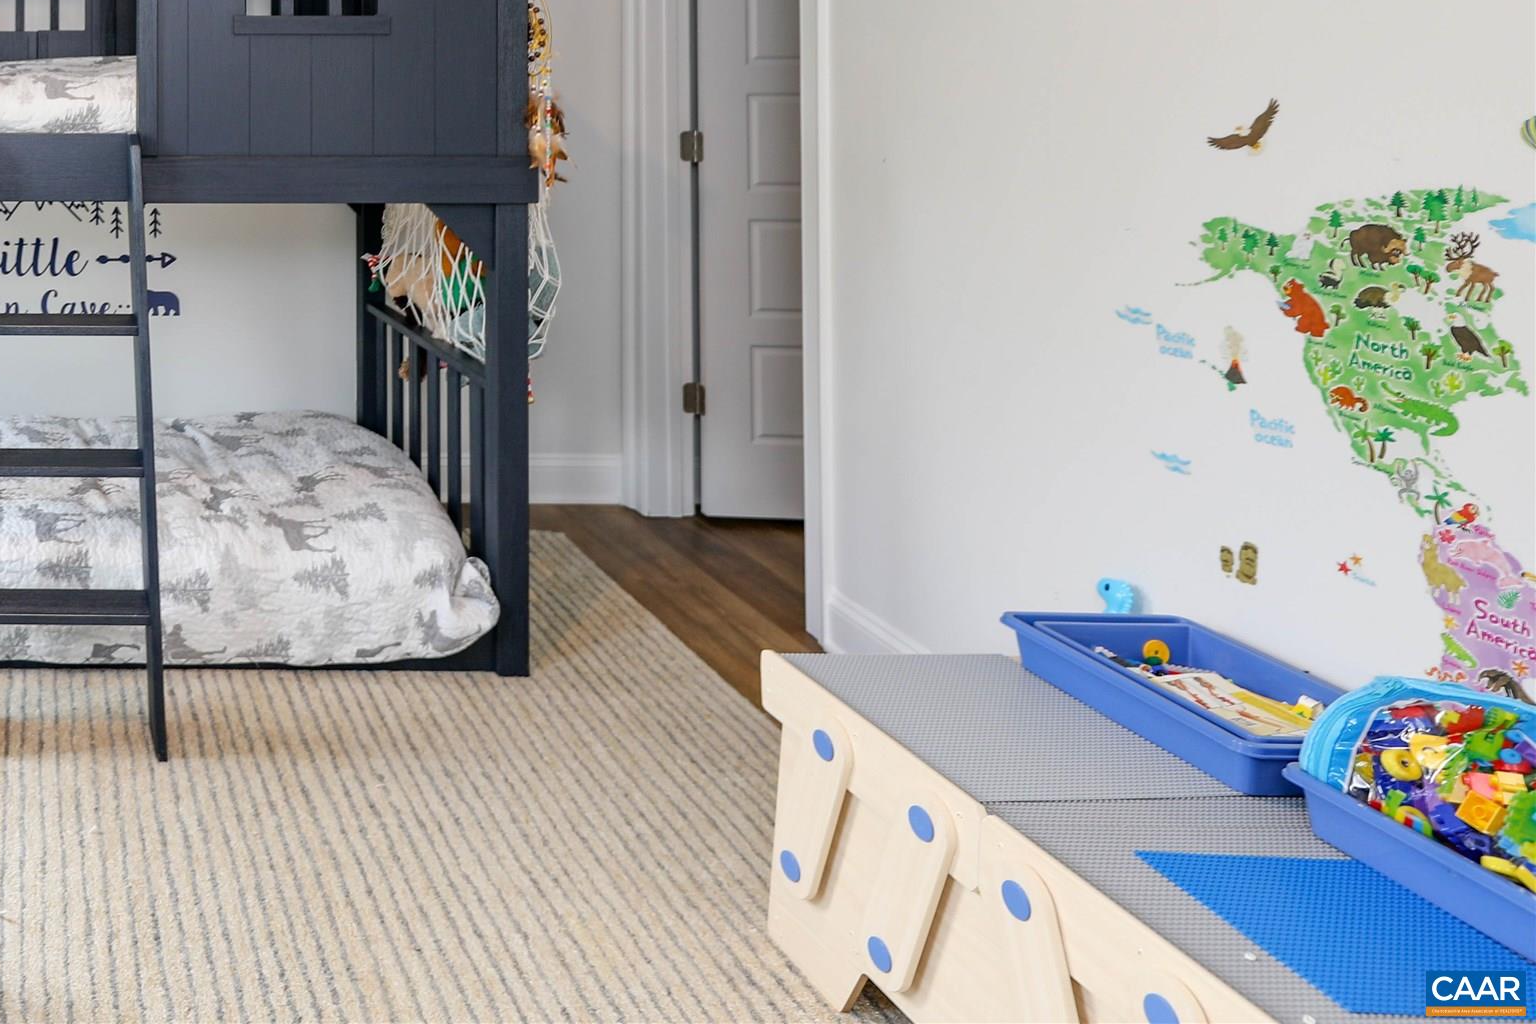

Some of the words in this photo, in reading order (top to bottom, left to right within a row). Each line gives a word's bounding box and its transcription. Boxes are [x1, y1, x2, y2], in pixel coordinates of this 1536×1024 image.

[1155, 323, 1196, 347] Pacific
[1354, 332, 1410, 361] North
[1349, 351, 1413, 382] America
[1249, 408, 1296, 435] Pacific
[1253, 432, 1294, 449] ocean
[1473, 598, 1531, 638] South
[1466, 620, 1536, 661] America
